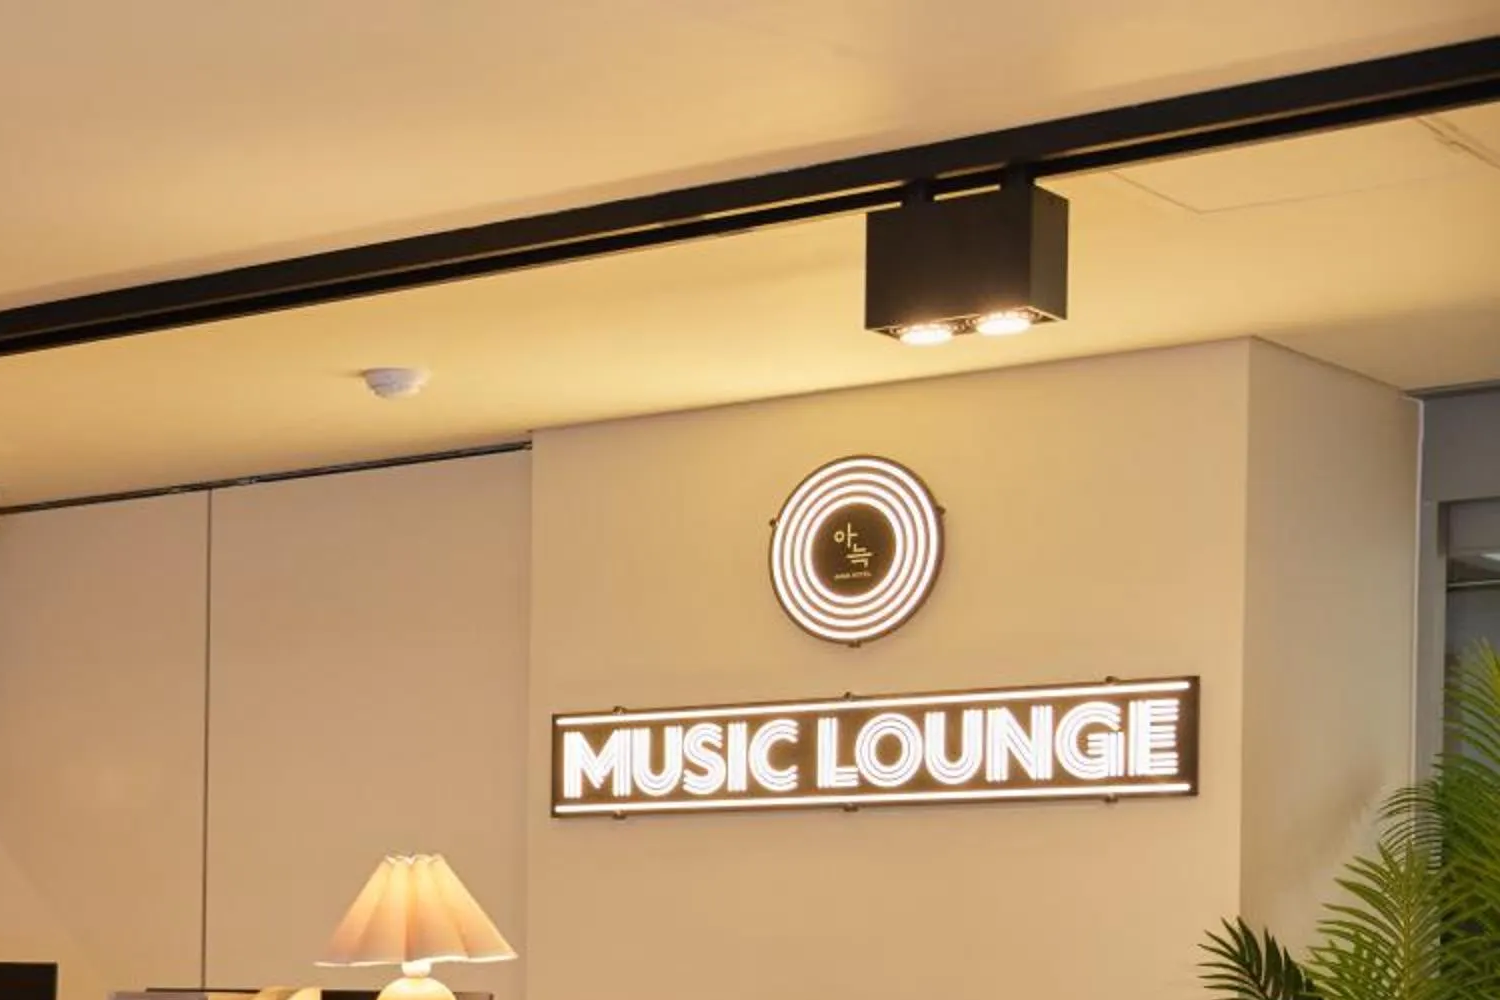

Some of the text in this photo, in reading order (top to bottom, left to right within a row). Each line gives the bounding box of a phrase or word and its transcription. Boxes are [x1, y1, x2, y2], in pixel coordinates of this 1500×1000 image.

[833, 522, 874, 568] 아늑
[563, 698, 1181, 798] MUSIC LOUNGE
